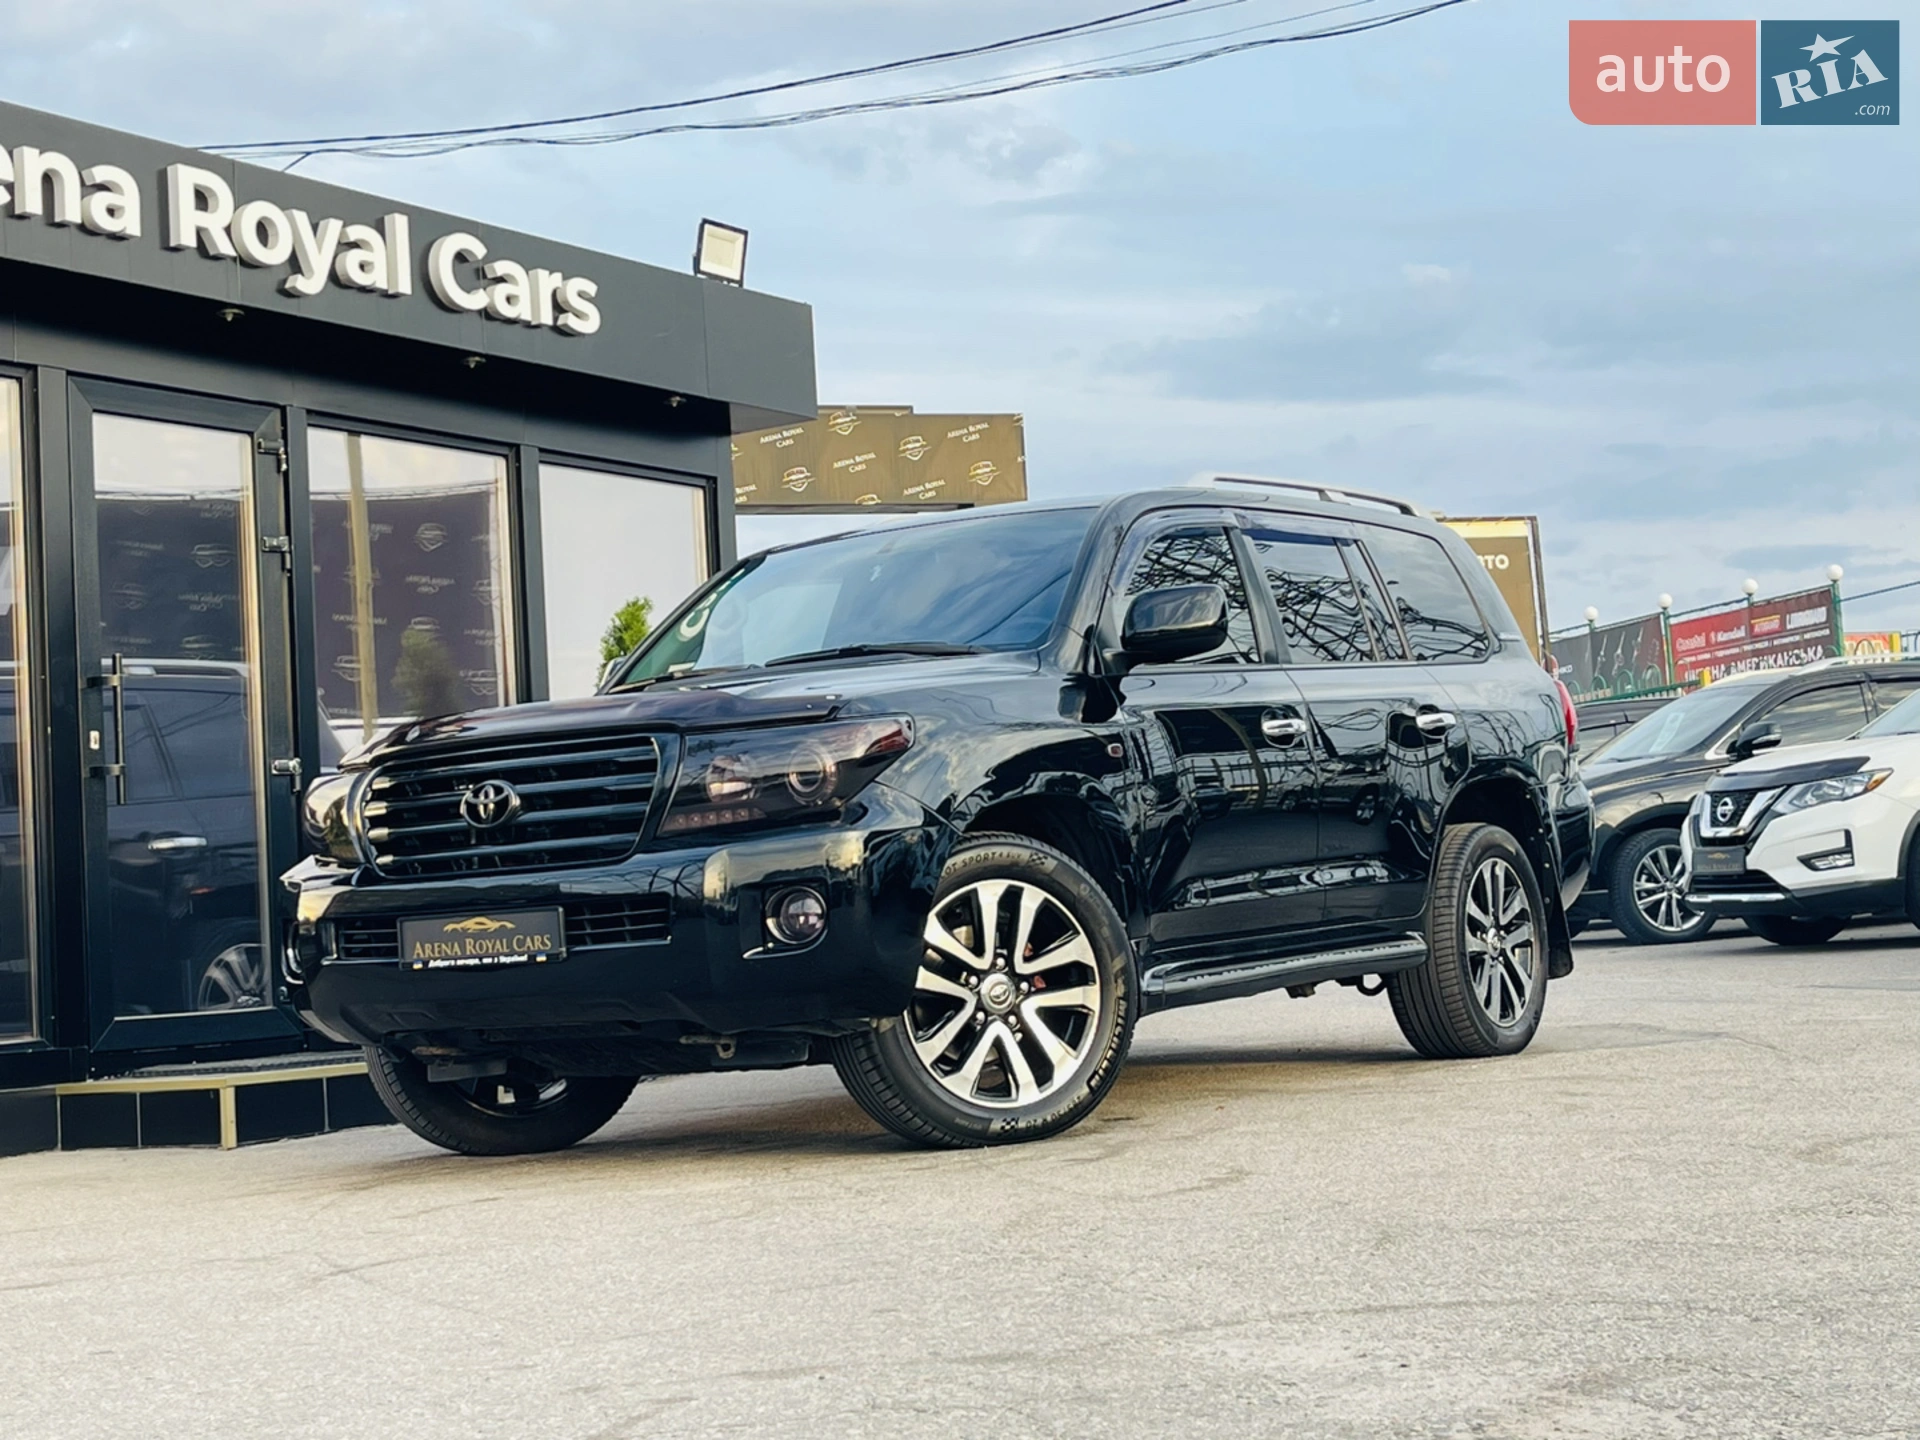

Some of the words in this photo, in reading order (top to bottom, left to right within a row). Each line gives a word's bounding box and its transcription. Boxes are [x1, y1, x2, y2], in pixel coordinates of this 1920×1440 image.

[166, 163, 412, 296] Royal
[428, 232, 601, 334] Cars
[412, 941, 462, 959] ARENA
[464, 937, 511, 956] ROYAL
[512, 934, 552, 951] CARS
